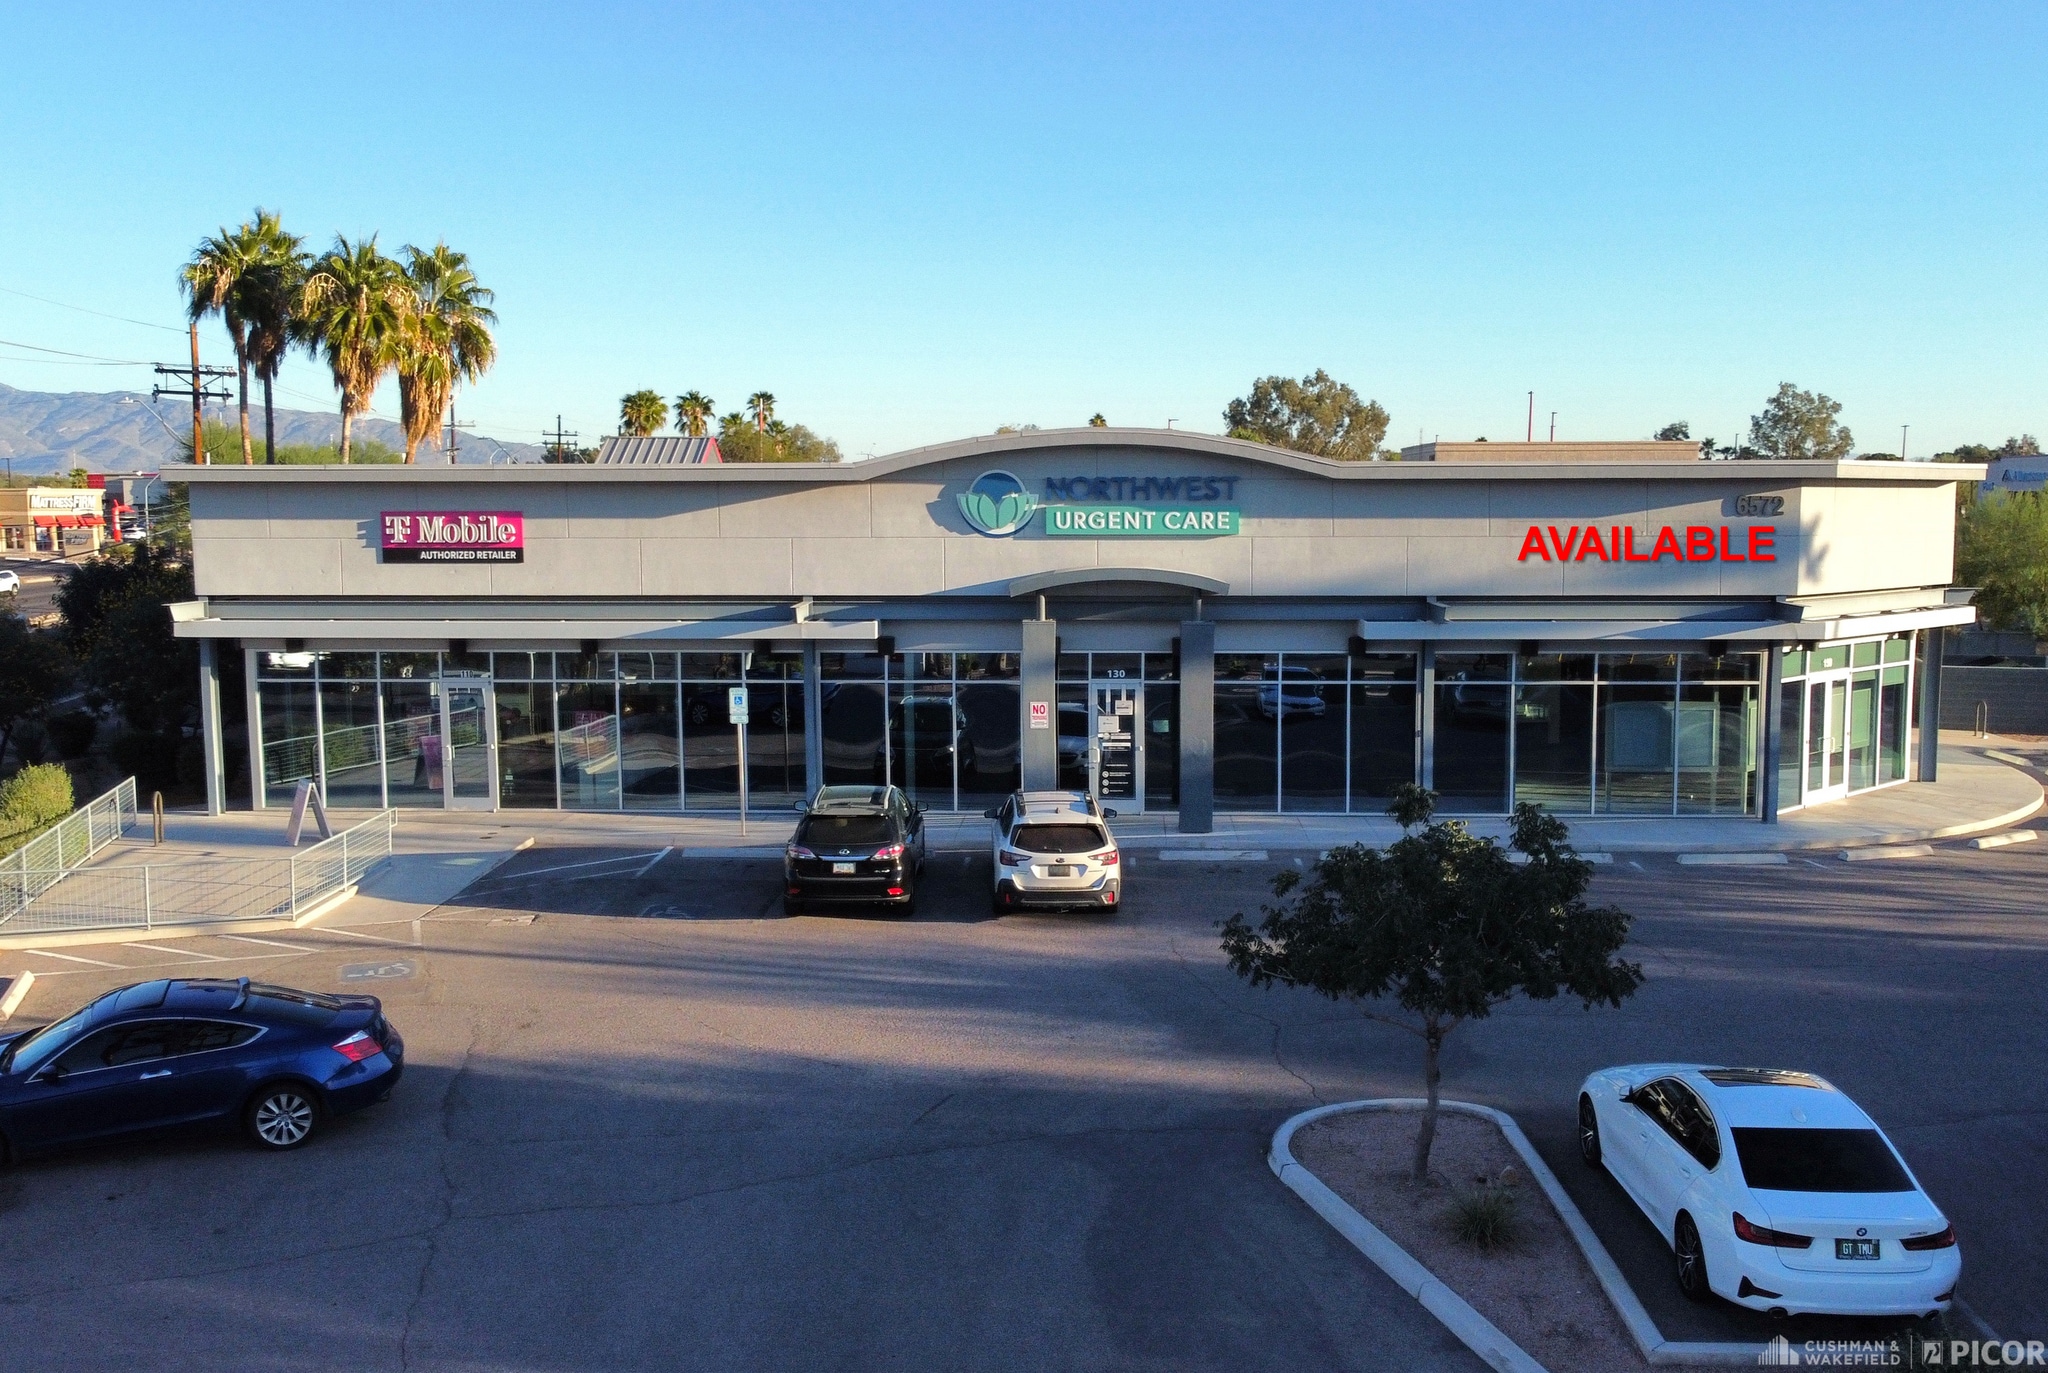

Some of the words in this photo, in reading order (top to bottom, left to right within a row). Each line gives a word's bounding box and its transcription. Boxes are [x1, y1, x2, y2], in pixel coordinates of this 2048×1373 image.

[1045, 476, 1238, 501] NORTHWEST
[1735, 495, 1785, 516] 6572
[1054, 511, 1156, 530] URGENT
[1163, 511, 1231, 530] CARE
[416, 515, 516, 543] Mobile
[420, 551, 475, 560] AUTHORIZED
[476, 551, 517, 560] RETAILER
[1107, 669, 1126, 678] 130
[1032, 704, 1046, 715] NO
[1842, 1243, 1853, 1255] GT
